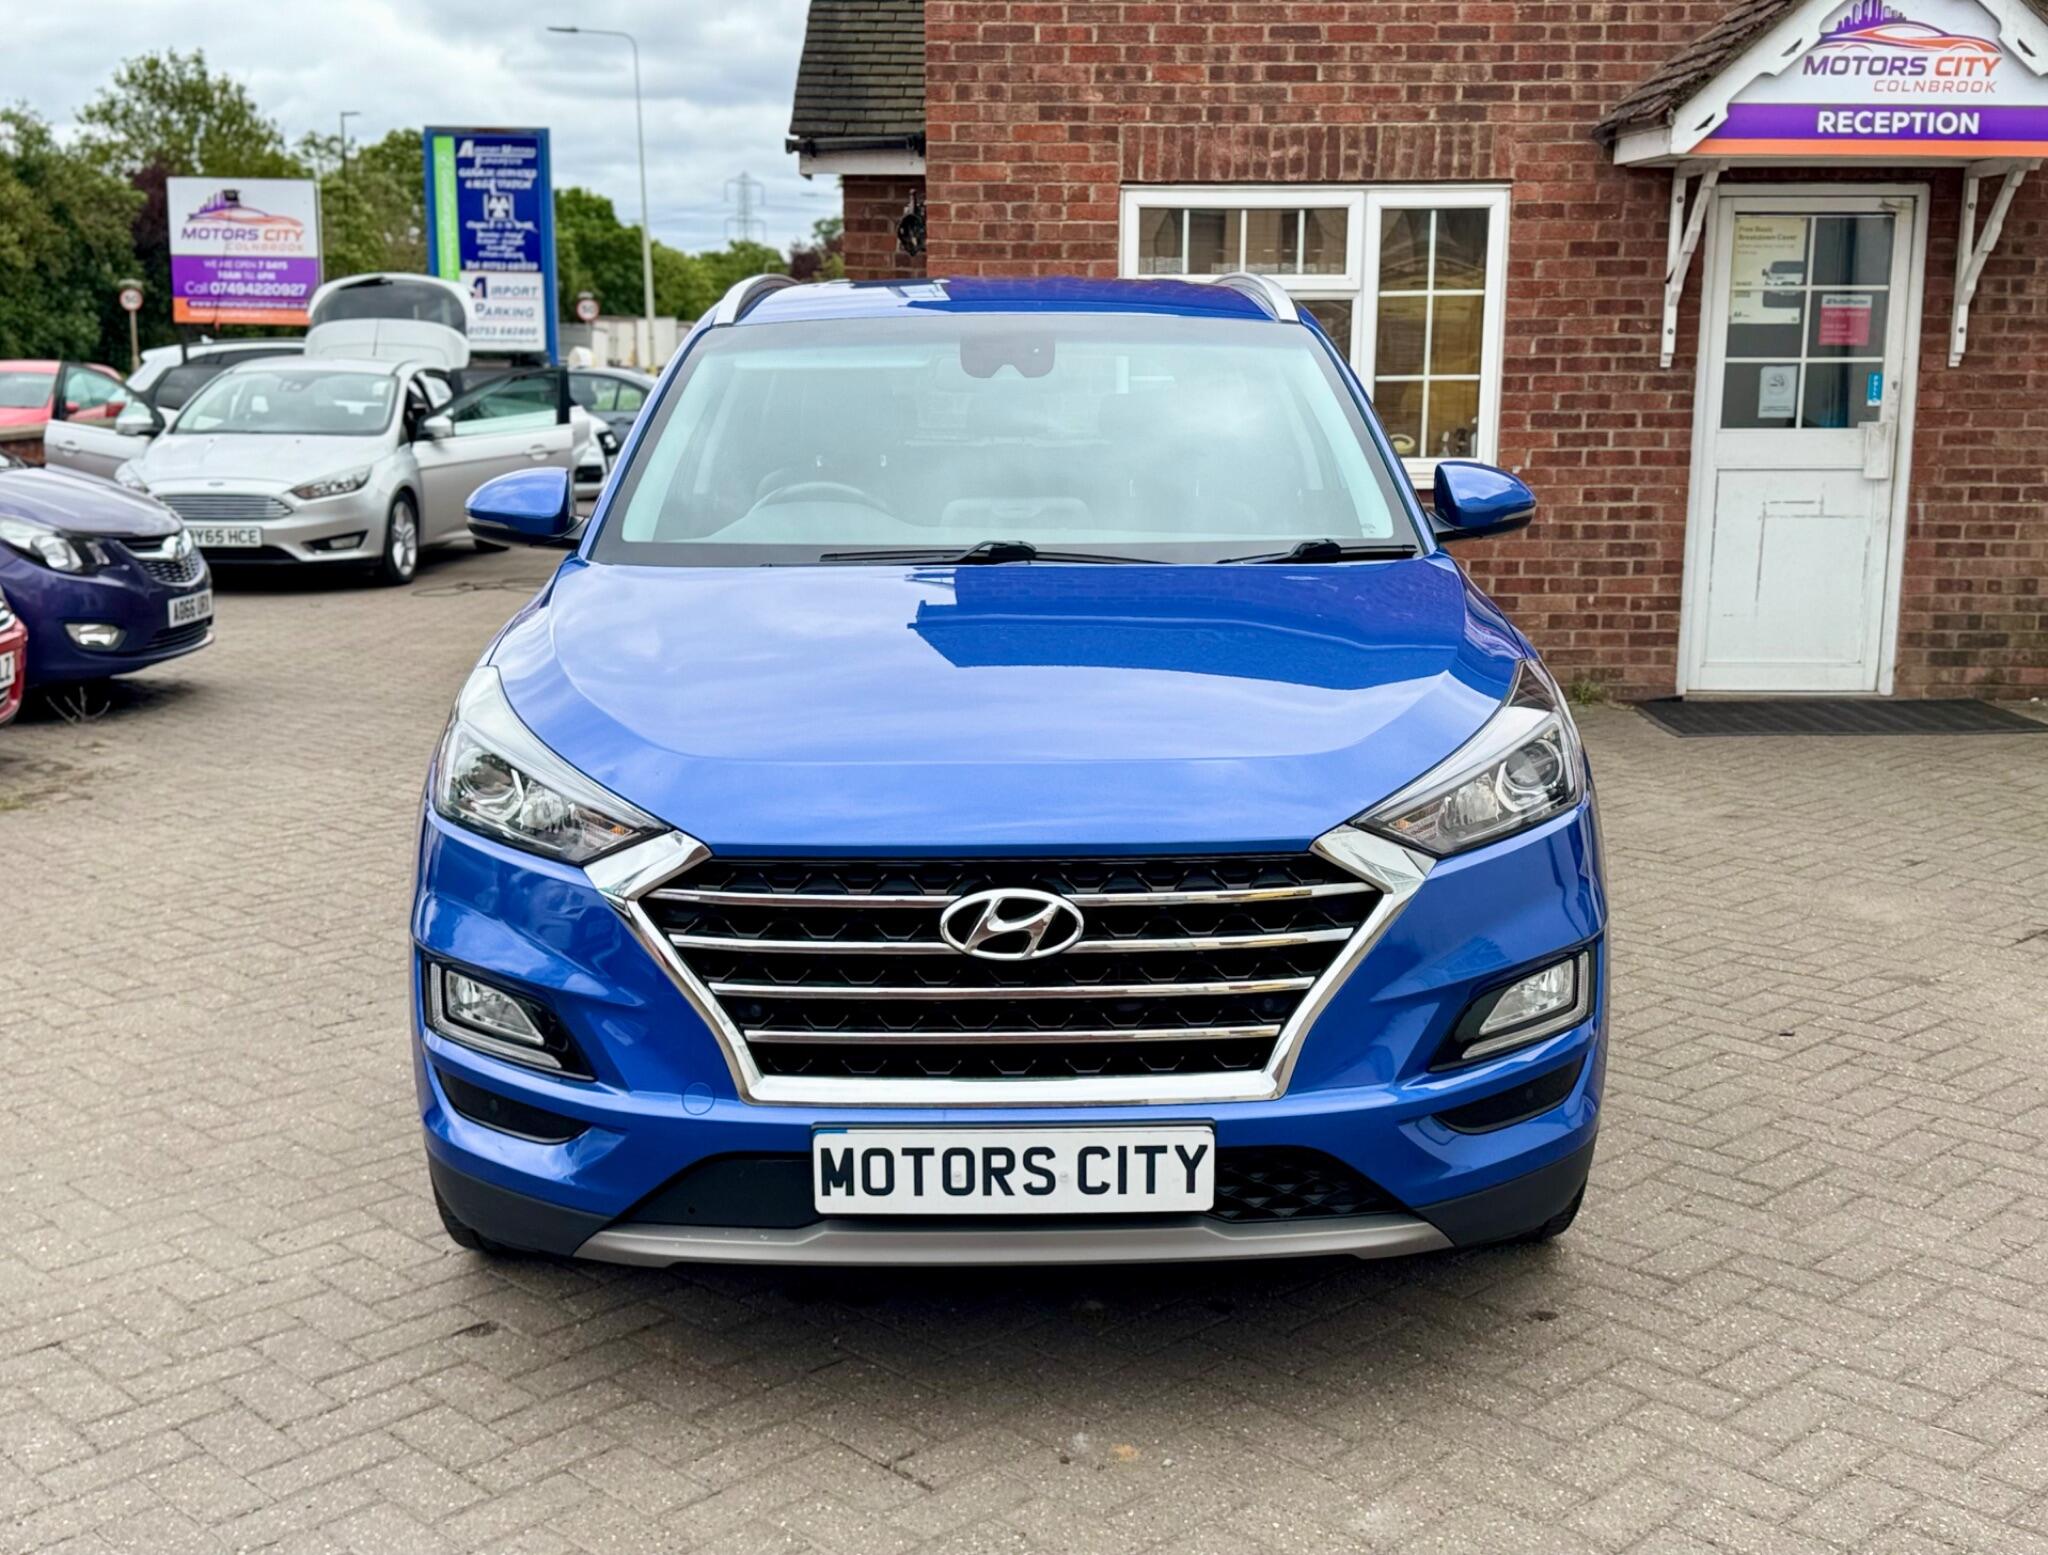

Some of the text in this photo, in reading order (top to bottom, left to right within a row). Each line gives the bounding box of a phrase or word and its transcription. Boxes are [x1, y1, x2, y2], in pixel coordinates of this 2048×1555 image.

[1802, 56, 2002, 77] MOTORS CITY
[1873, 80, 1998, 94] COLNBROOK
[1817, 111, 1980, 134] RECEPTION
[181, 227, 304, 242] MOTORS CITY
[265, 261, 288, 270] DAYS
[184, 281, 208, 294] Call
[475, 303, 534, 317] PARKING
[228, 530, 258, 544] HCE
[821, 1145, 1208, 1196] MOTORS CITY
